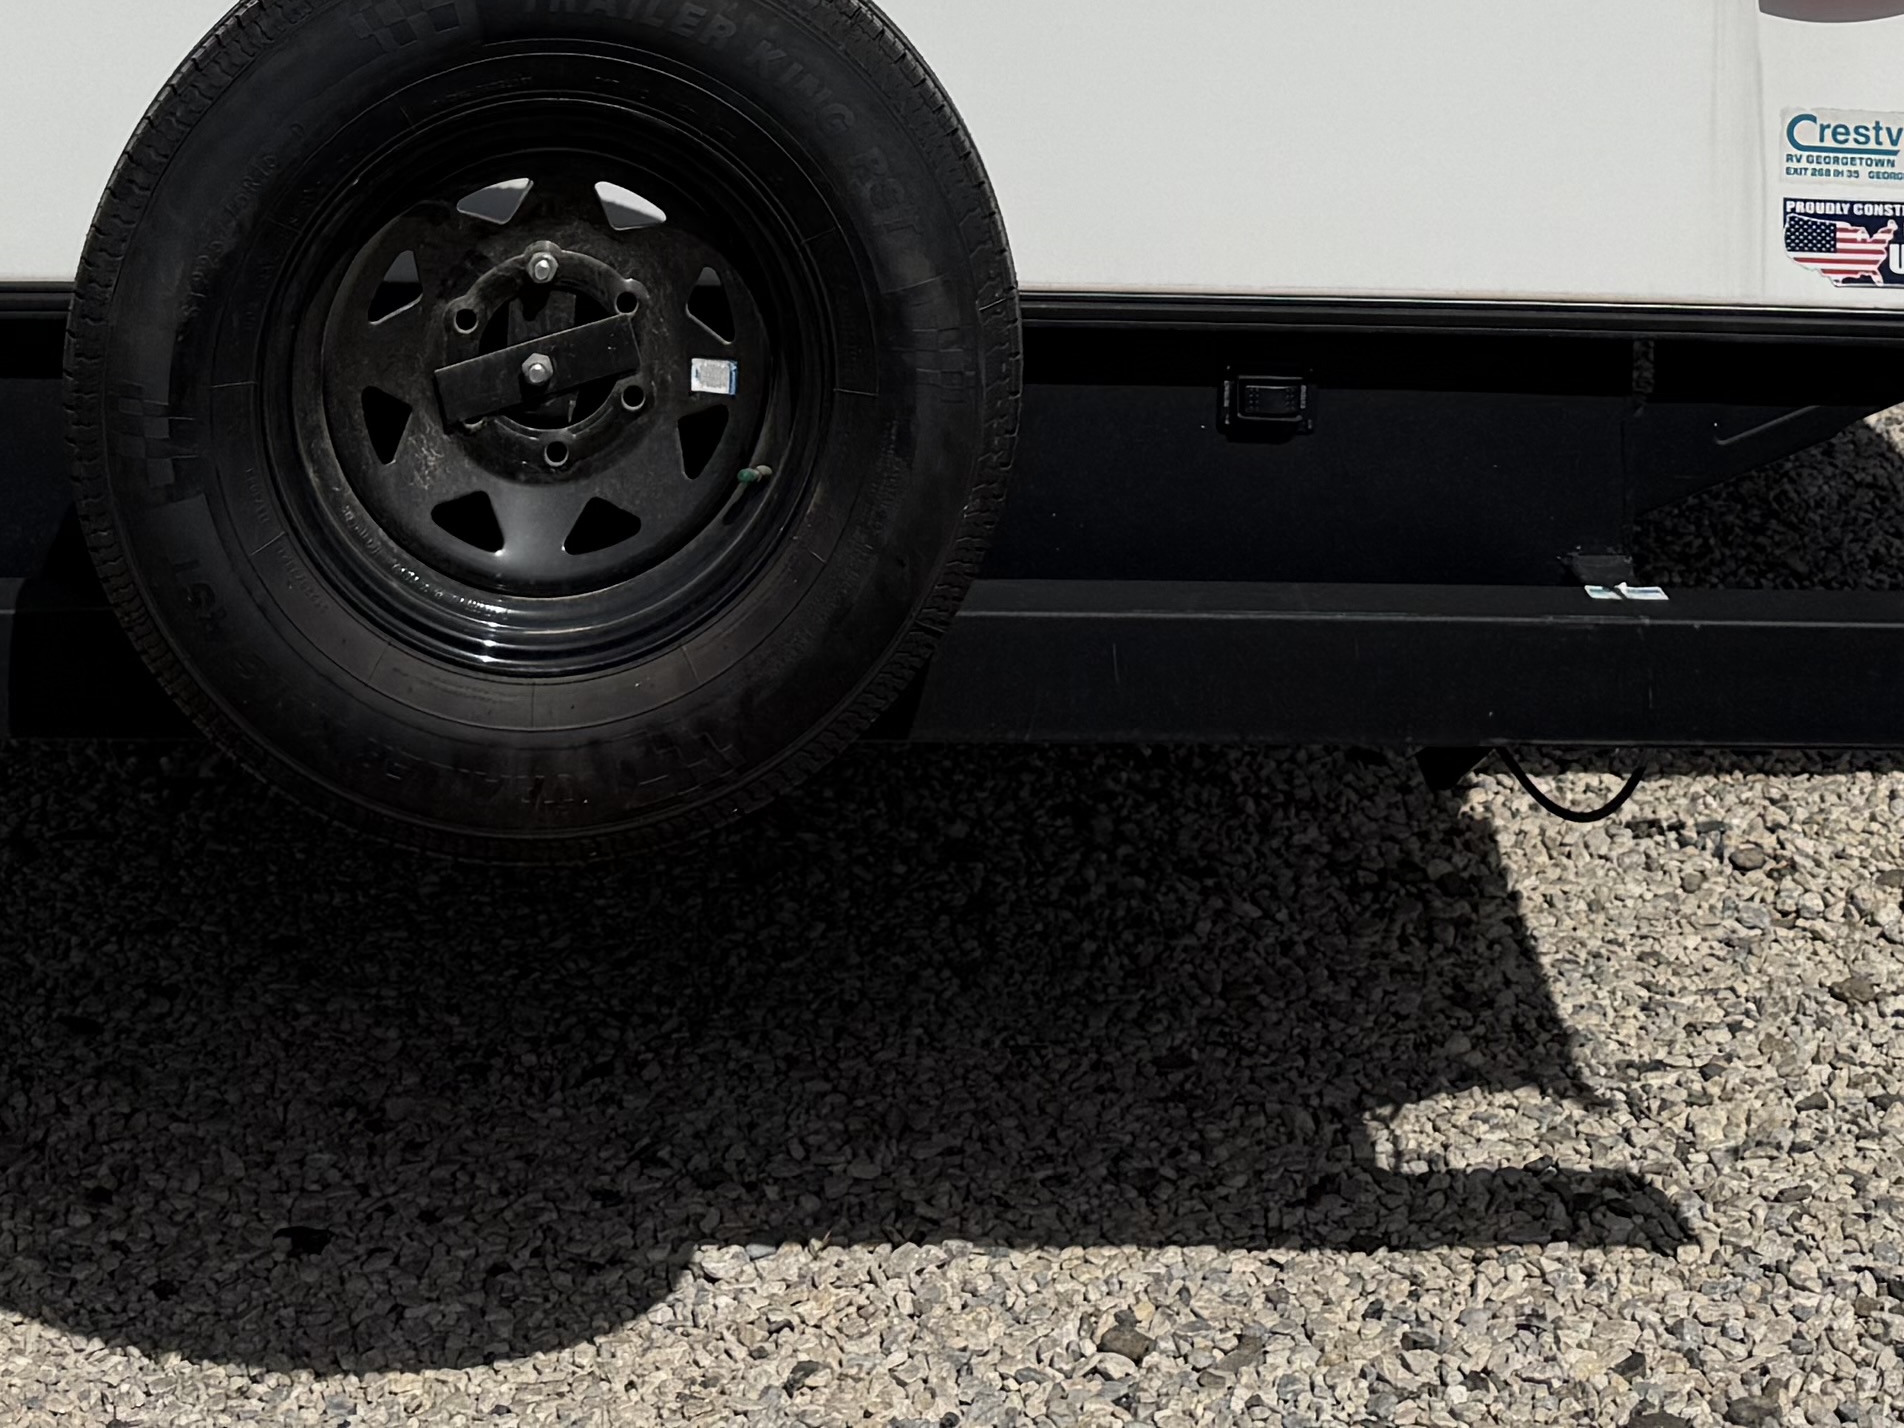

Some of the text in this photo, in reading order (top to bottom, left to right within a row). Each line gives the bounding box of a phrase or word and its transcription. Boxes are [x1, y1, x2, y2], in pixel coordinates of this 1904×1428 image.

[743, 36, 856, 138] KING
[1786, 153, 1896, 168] RV GEORGETOWN
[1786, 167, 1809, 176] EXIT
[1786, 200, 1850, 215] PROUDLY
